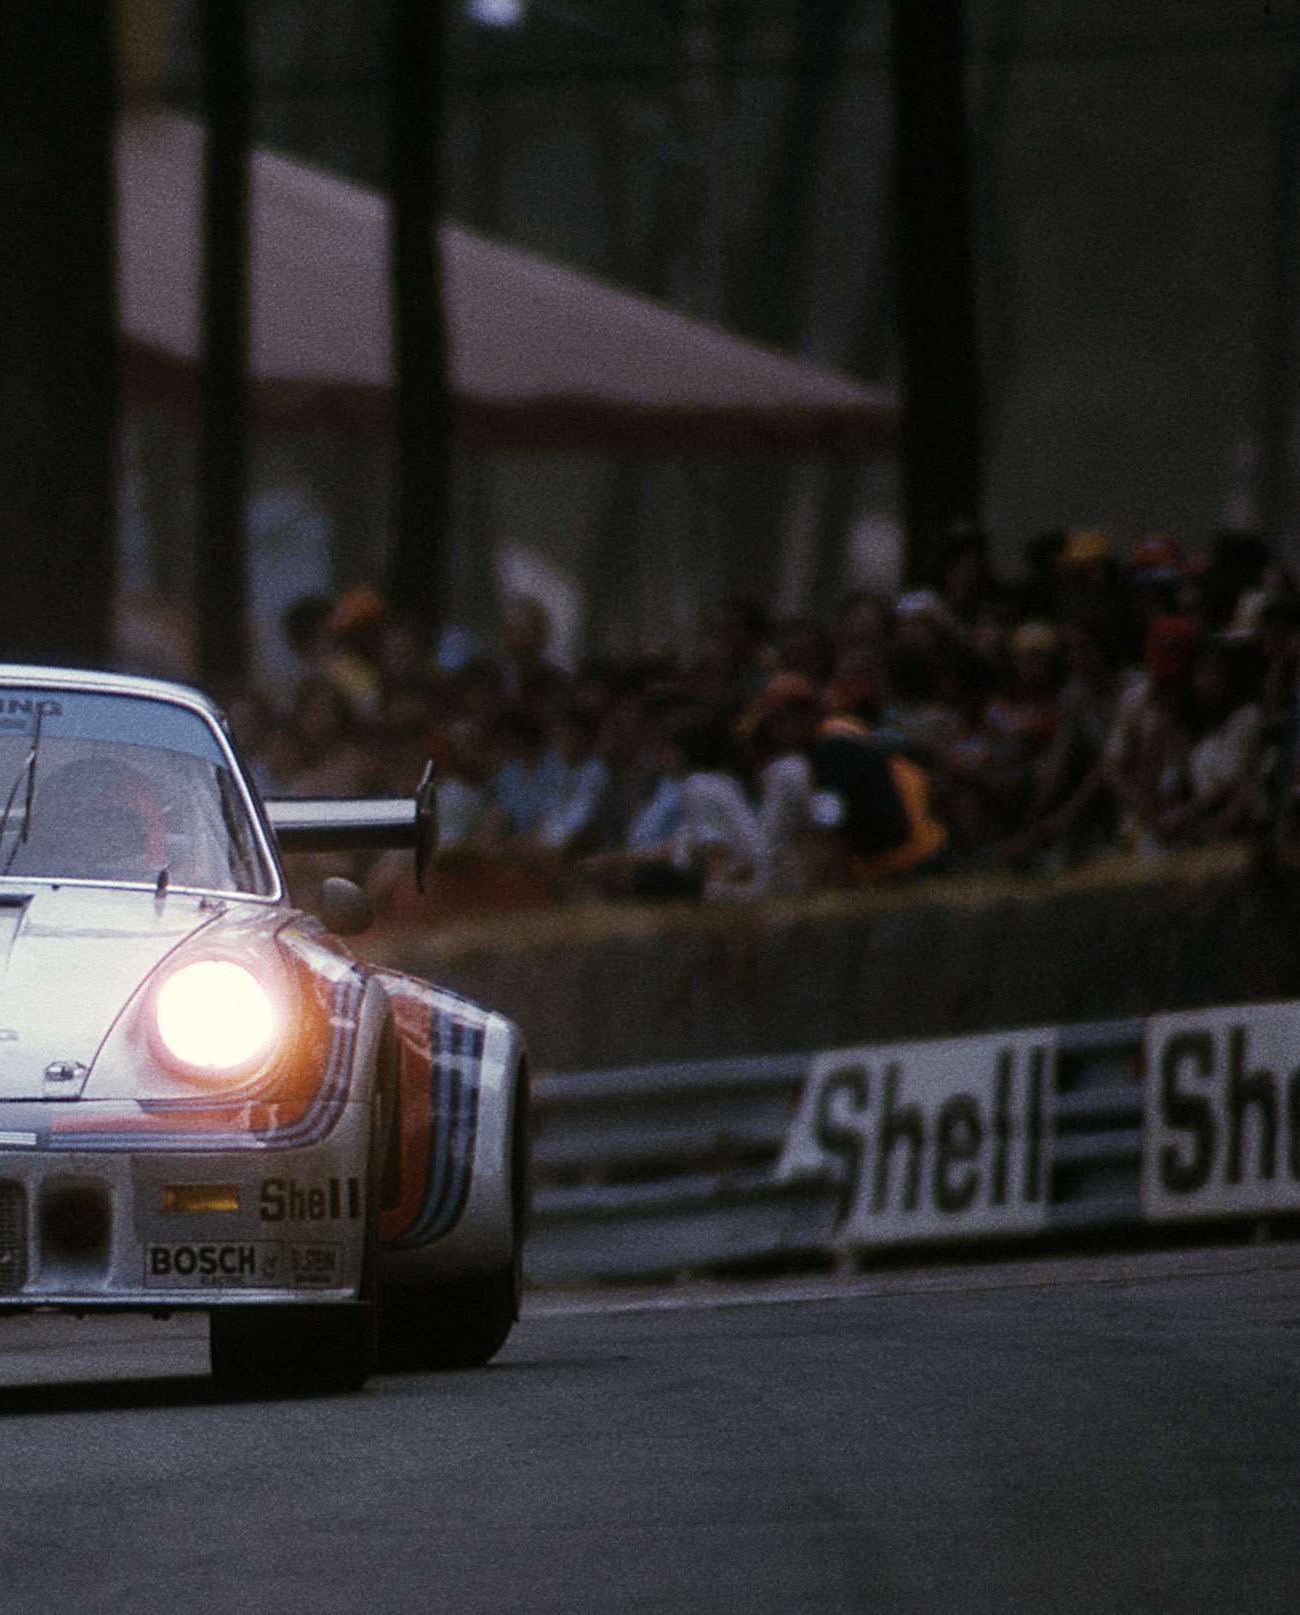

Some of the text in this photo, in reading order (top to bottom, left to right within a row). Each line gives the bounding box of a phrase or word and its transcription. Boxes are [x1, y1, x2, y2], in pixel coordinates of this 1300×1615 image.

[815, 1045, 1046, 1232] Shell
[1160, 1025, 1300, 1194] Sh
[260, 1178, 361, 1221] Shell
[151, 1246, 256, 1275] BOSCH
